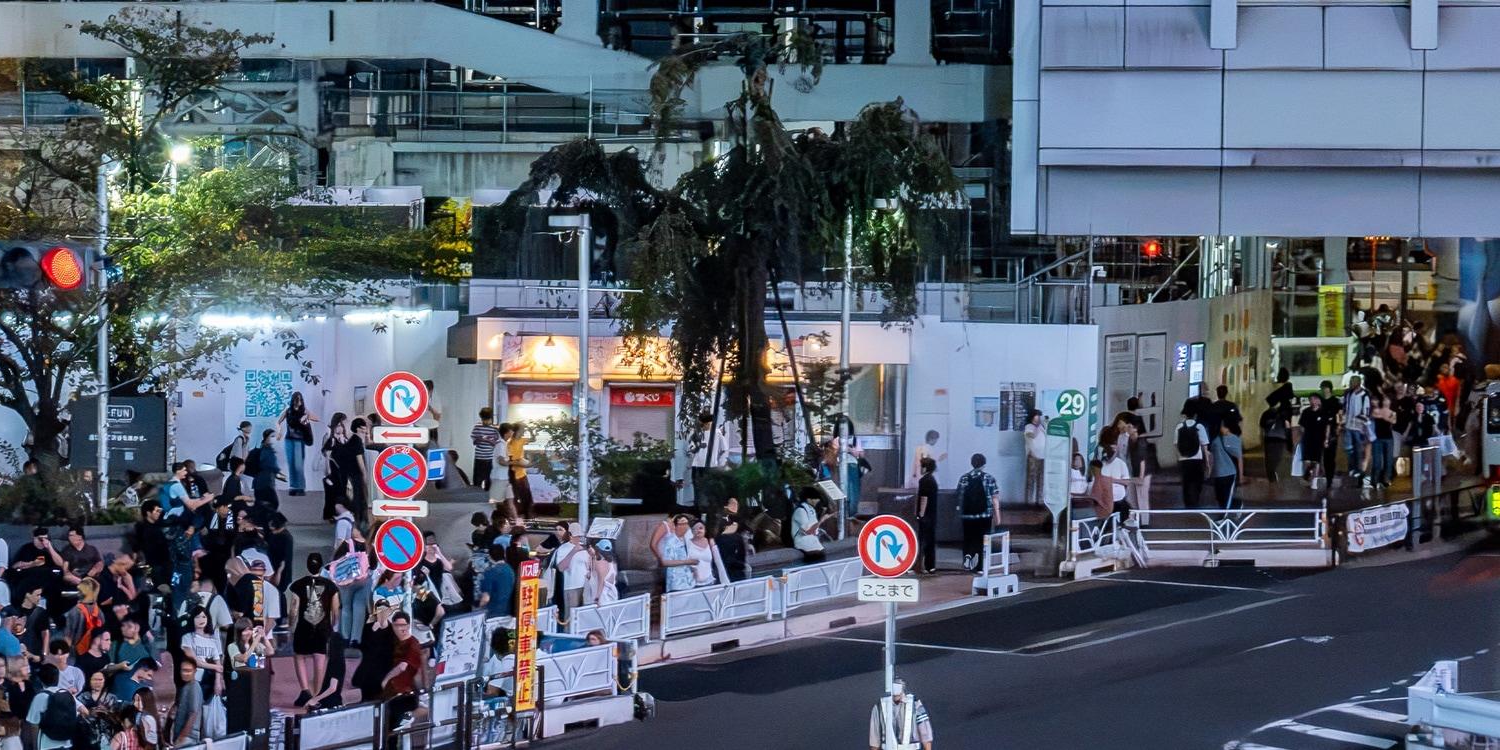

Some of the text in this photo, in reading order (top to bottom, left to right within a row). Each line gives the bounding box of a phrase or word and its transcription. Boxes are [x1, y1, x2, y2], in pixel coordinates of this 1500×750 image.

[1059, 393, 1085, 415] 29
[862, 584, 914, 597] ここまで
[518, 585, 534, 704] 駐停車禁止
